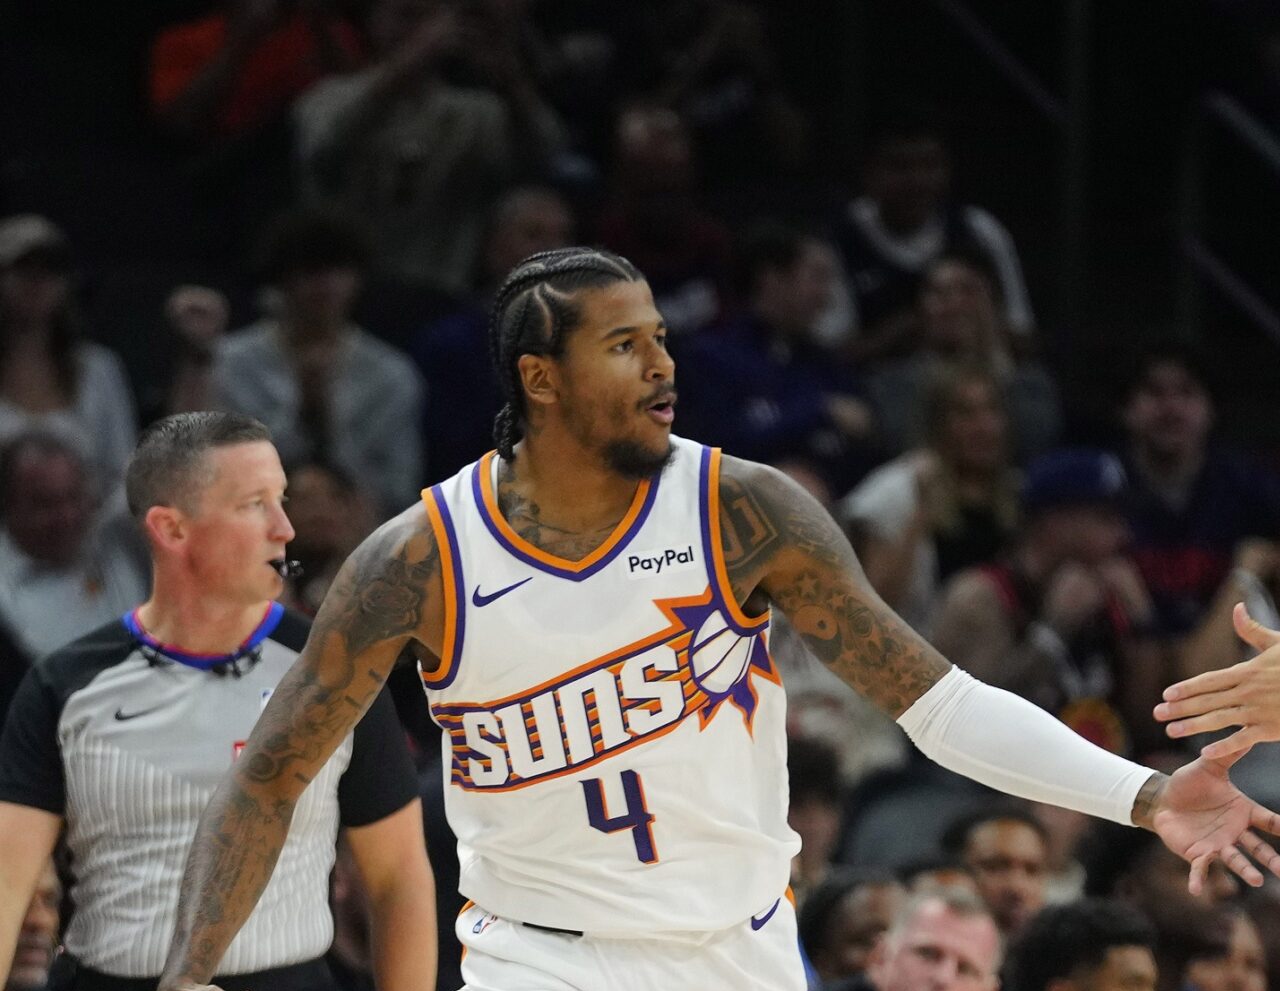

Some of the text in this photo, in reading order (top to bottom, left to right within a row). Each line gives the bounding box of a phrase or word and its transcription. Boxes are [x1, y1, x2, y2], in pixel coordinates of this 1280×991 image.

[628, 546, 694, 573] PayPal
[461, 643, 686, 787] SUNS
[578, 769, 660, 865] 4
